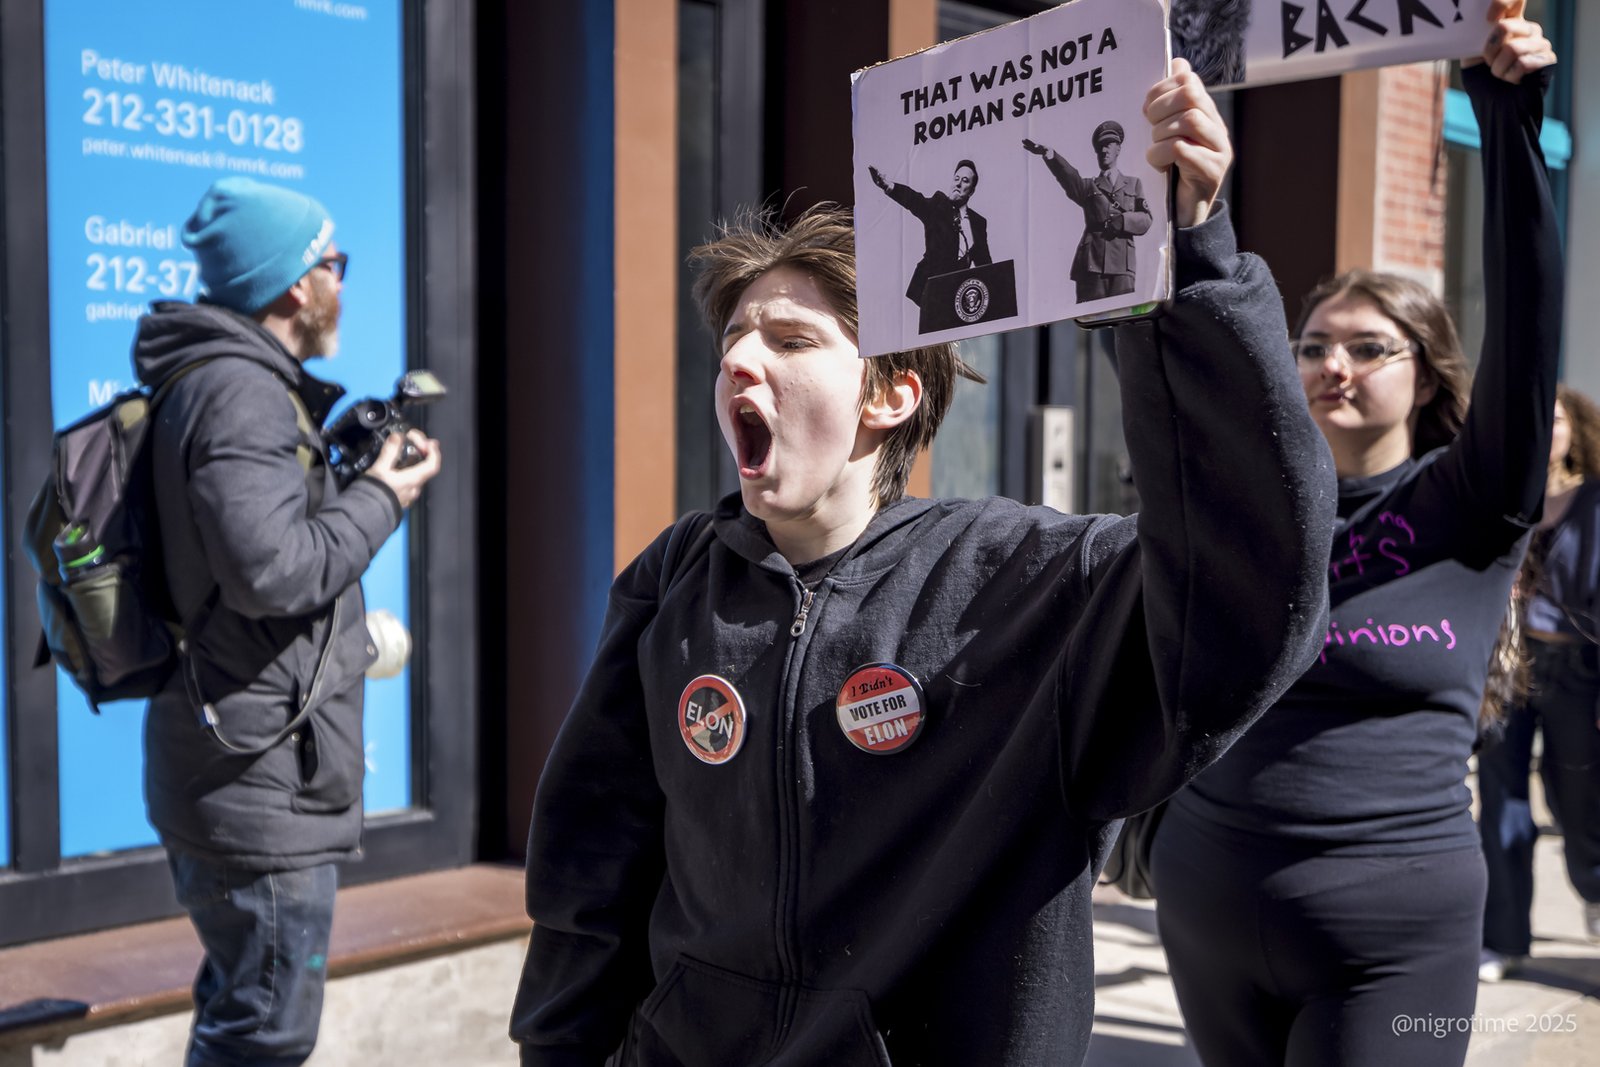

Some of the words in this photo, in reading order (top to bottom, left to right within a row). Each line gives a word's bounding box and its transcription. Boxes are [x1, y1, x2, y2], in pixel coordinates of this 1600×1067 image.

[81, 49, 145, 84] Peter
[151, 61, 274, 105] Whitenack
[901, 76, 962, 115] THAT
[970, 55, 1033, 93] WAS
[1041, 33, 1093, 74] NOT
[1097, 27, 1117, 55] A
[82, 88, 303, 153] 212-331-0128
[914, 98, 1004, 145] ROMAN
[1011, 67, 1103, 118] SALUTE
[85, 215, 174, 250] Gabriel
[859, 675, 894, 695] Didn't
[686, 700, 734, 740] ELON
[849, 701, 882, 722] VOTE
[882, 694, 907, 713] FOR
[863, 718, 908, 746] ELON
